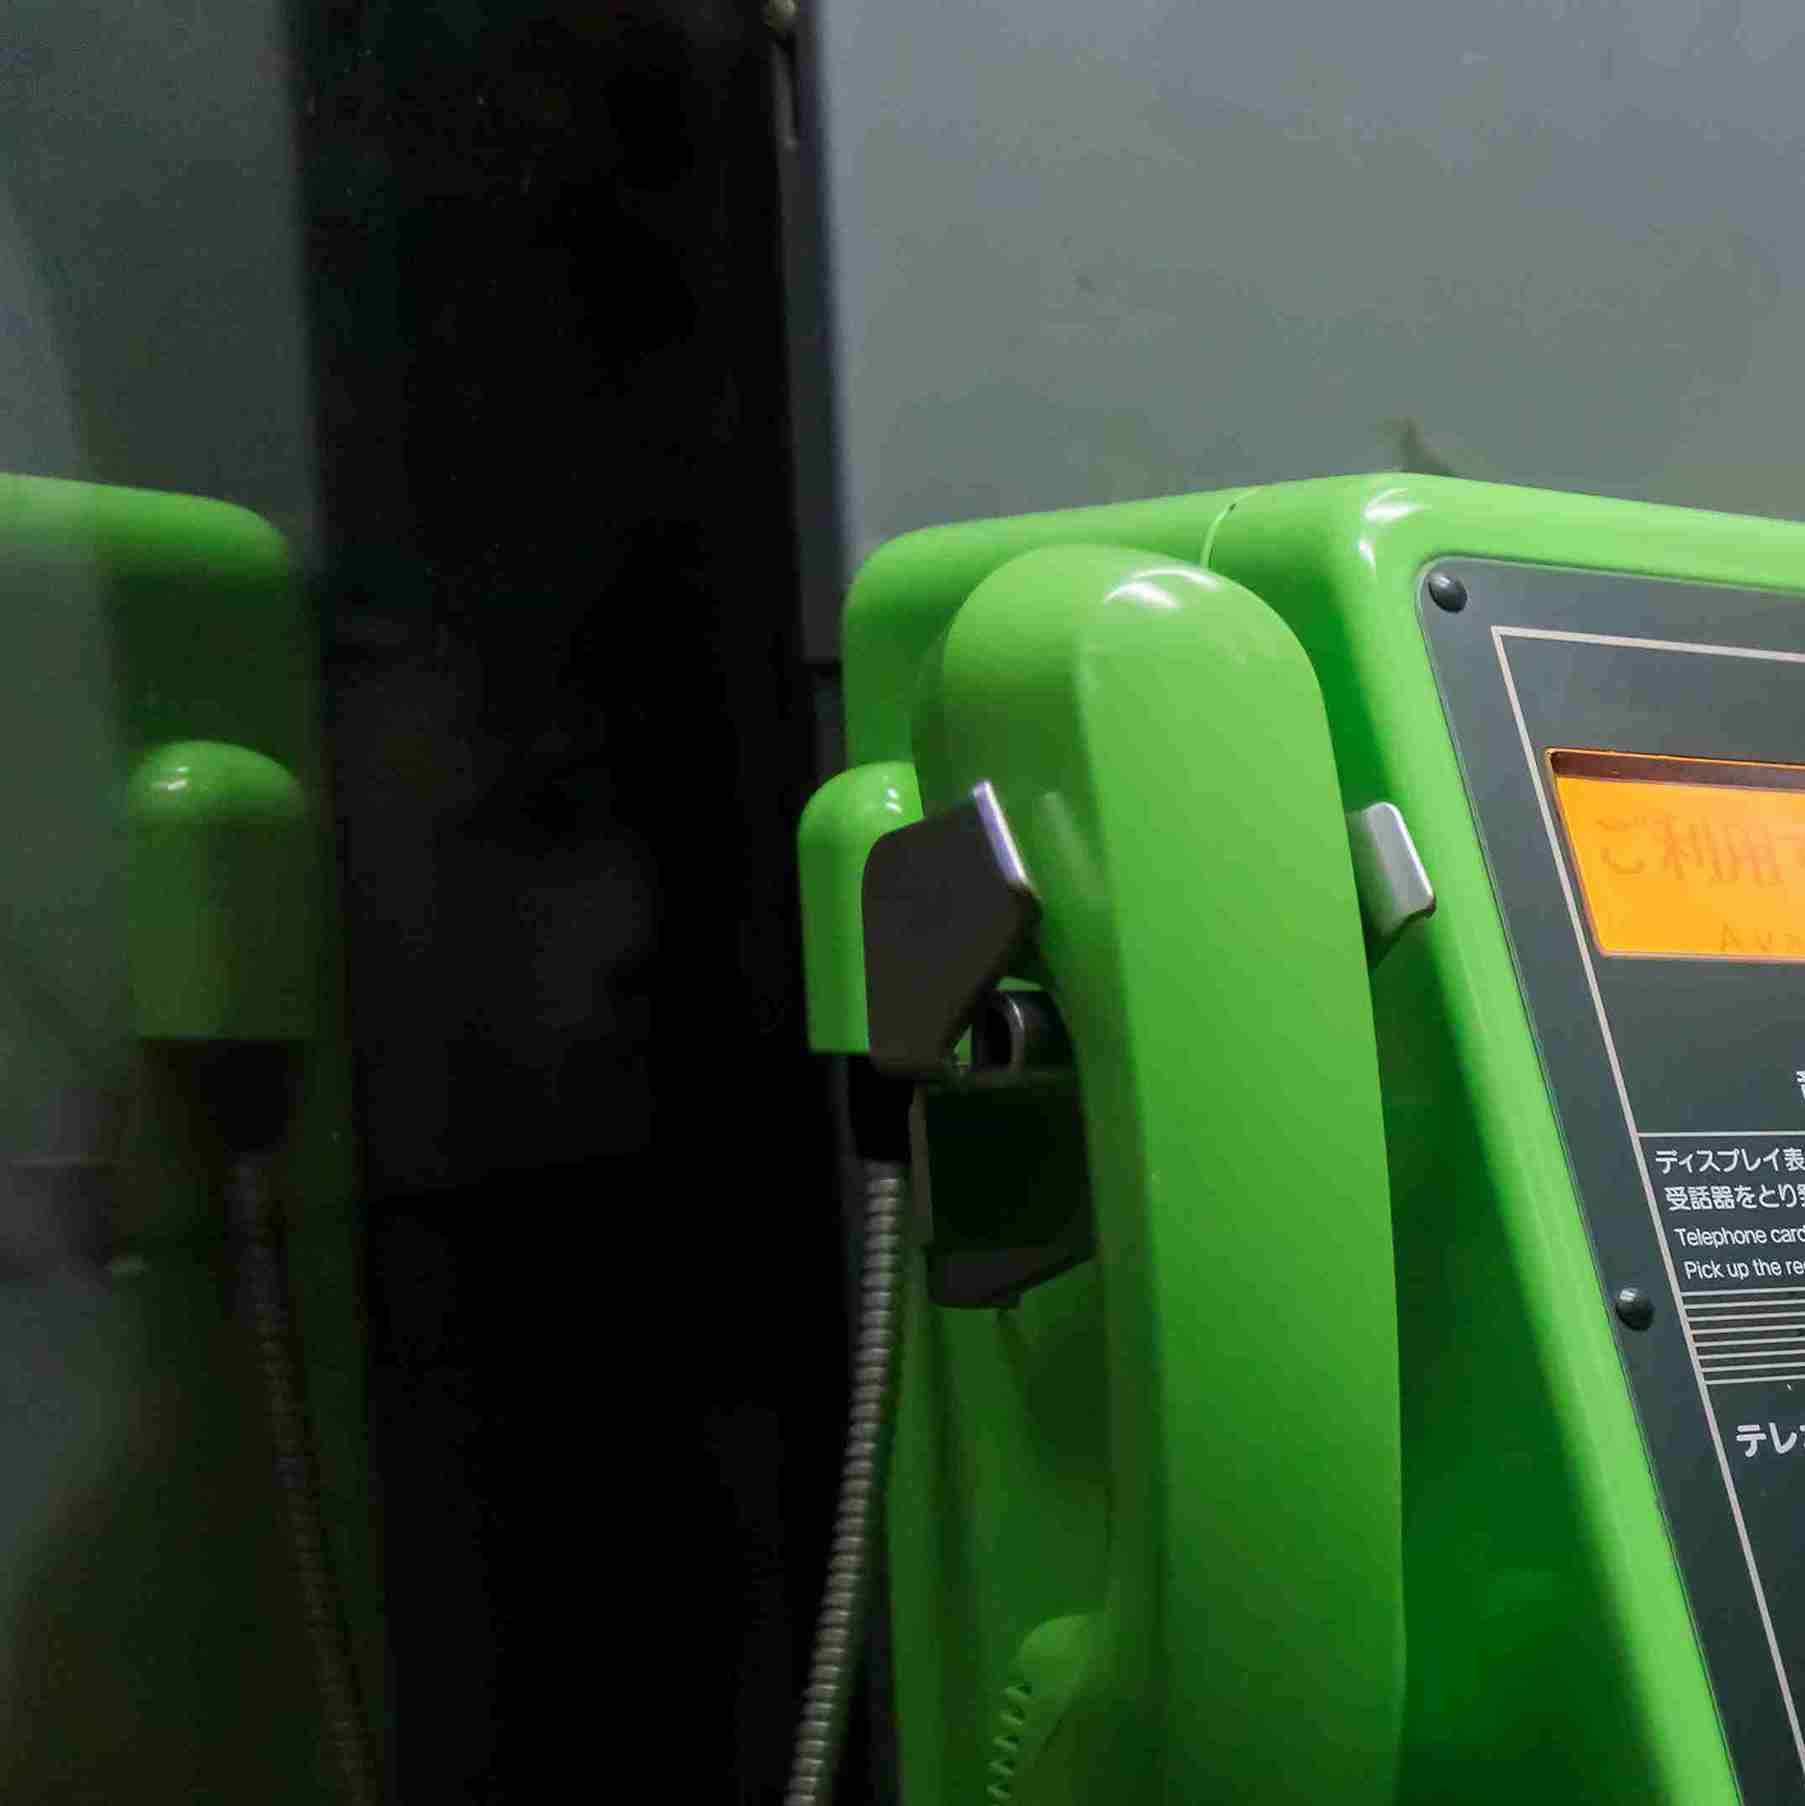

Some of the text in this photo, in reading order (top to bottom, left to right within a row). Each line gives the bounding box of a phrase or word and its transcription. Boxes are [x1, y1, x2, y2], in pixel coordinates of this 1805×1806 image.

[1673, 1226, 1768, 1248] Telephone
[1683, 1259, 1725, 1280] Pick
[1727, 1262, 1750, 1280] up
[1752, 1258, 1782, 1276] the
